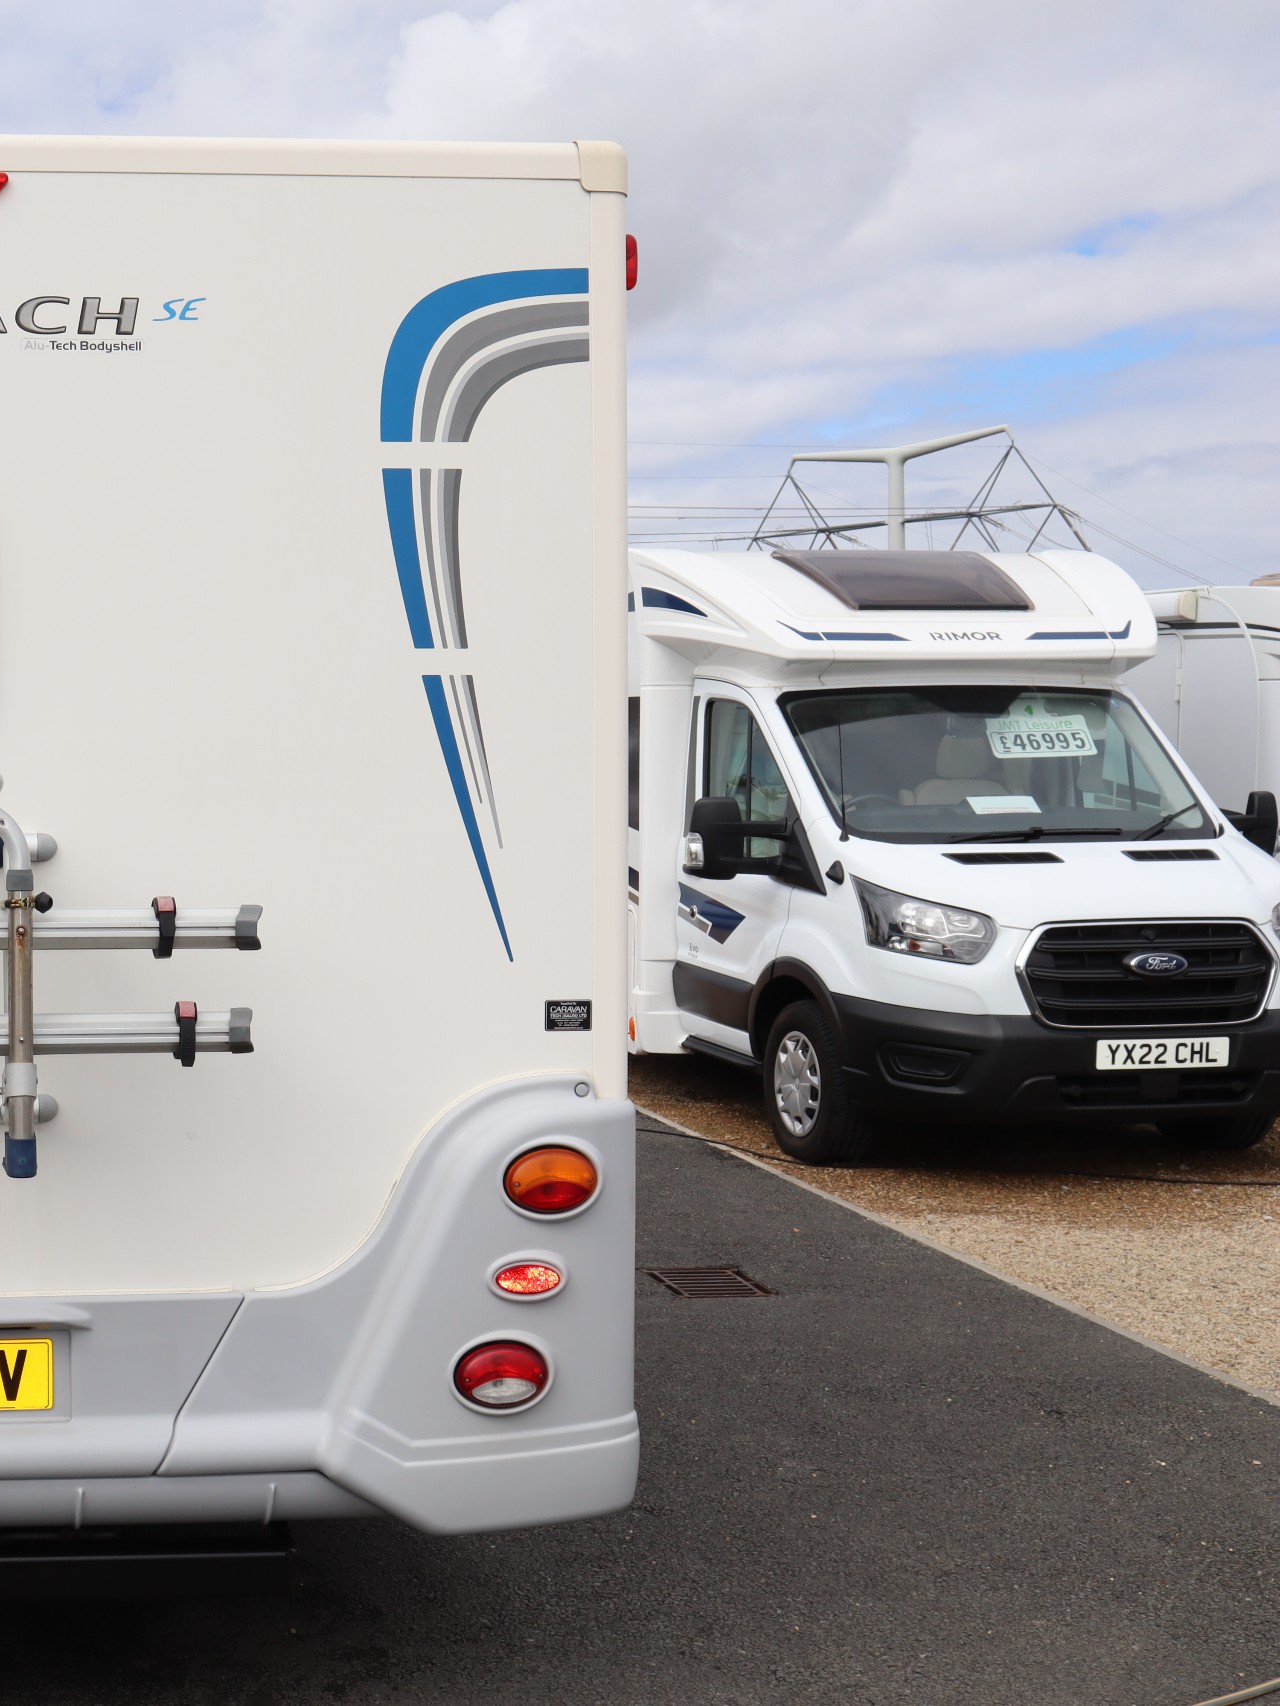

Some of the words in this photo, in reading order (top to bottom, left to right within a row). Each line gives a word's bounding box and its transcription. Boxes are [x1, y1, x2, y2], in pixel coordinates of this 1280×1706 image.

[152, 297, 207, 321] SE
[24, 340, 77, 351] Alu-Tech
[80, 340, 142, 354] Bodyshell
[929, 631, 1003, 641] RIMOR
[998, 720, 1021, 731] JMT
[1025, 719, 1073, 731] Leisure
[999, 731, 1086, 753] £46995
[1145, 956, 1177, 970] Ford
[1107, 1043, 1168, 1065] YX22
[1174, 1042, 1218, 1064] CHL
